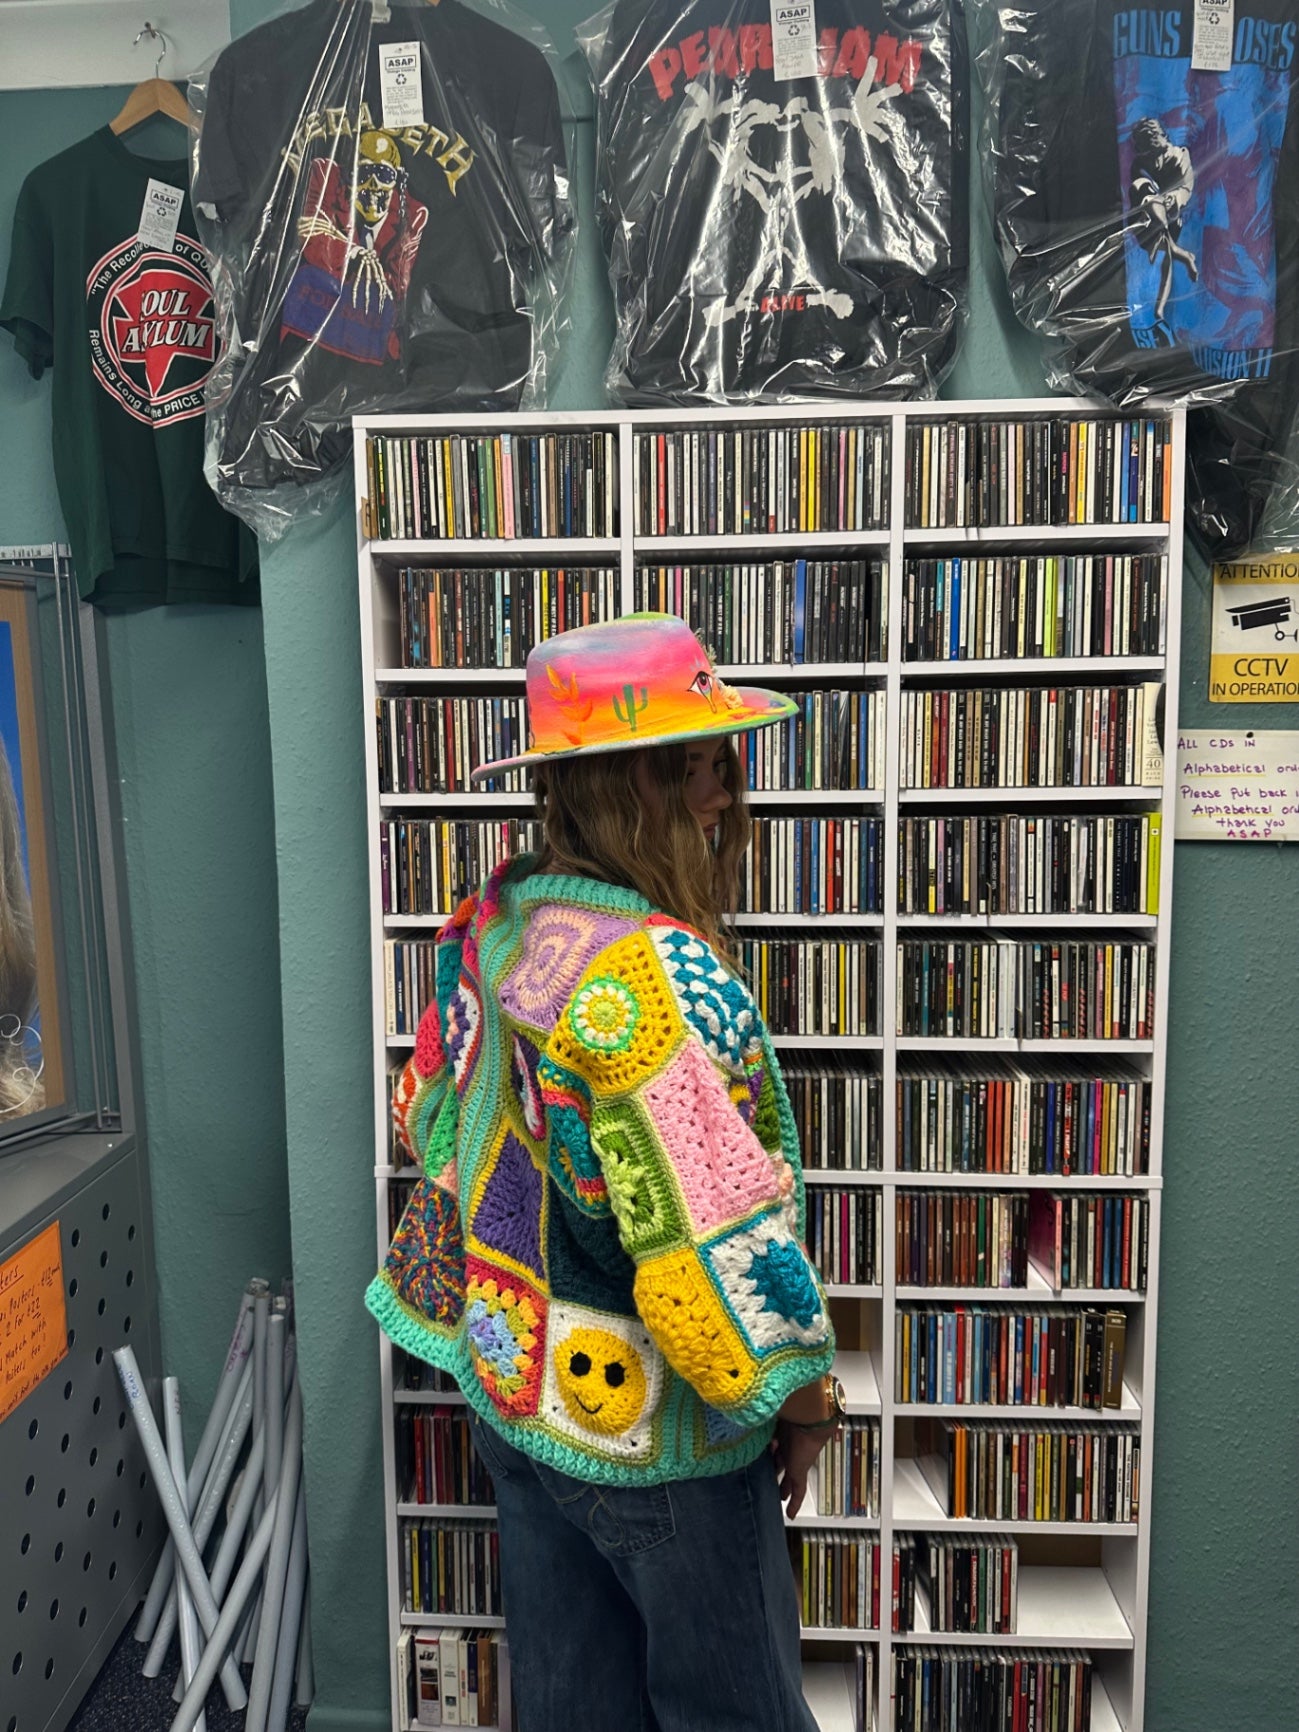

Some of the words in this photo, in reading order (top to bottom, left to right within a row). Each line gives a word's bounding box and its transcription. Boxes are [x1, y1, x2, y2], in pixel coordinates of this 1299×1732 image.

[780, 8, 807, 18] ASAP
[1113, 10, 1181, 59] GUNS
[1234, 16, 1296, 70] OSES
[388, 58, 414, 68] ASAP
[648, 22, 773, 102] PEAR
[280, 101, 479, 198] MEGAETH
[153, 192, 176, 205] ASAP
[176, 243, 189, 255] of
[142, 288, 191, 317] OUL
[122, 318, 211, 354] AYLUM
[88, 329, 116, 382] Remains
[116, 380, 142, 412] Long
[164, 393, 200, 415] PRICE
[1220, 564, 1299, 579] ATTENTIO
[1234, 658, 1289, 677] CCTV
[1212, 682, 1226, 696] IN
[1229, 682, 1299, 696] OPERATIO
[1178, 737, 1198, 750] ALL
[1244, 739, 1256, 748] IN
[1146, 758, 1160, 768] 40
[1184, 763, 1266, 776] Alphabetical
[1276, 764, 1299, 773] ord
[1180, 785, 1222, 799] Please
[1259, 788, 1288, 798] back
[1216, 818, 1257, 828] thank
[0, 1264, 18, 1290] ters
